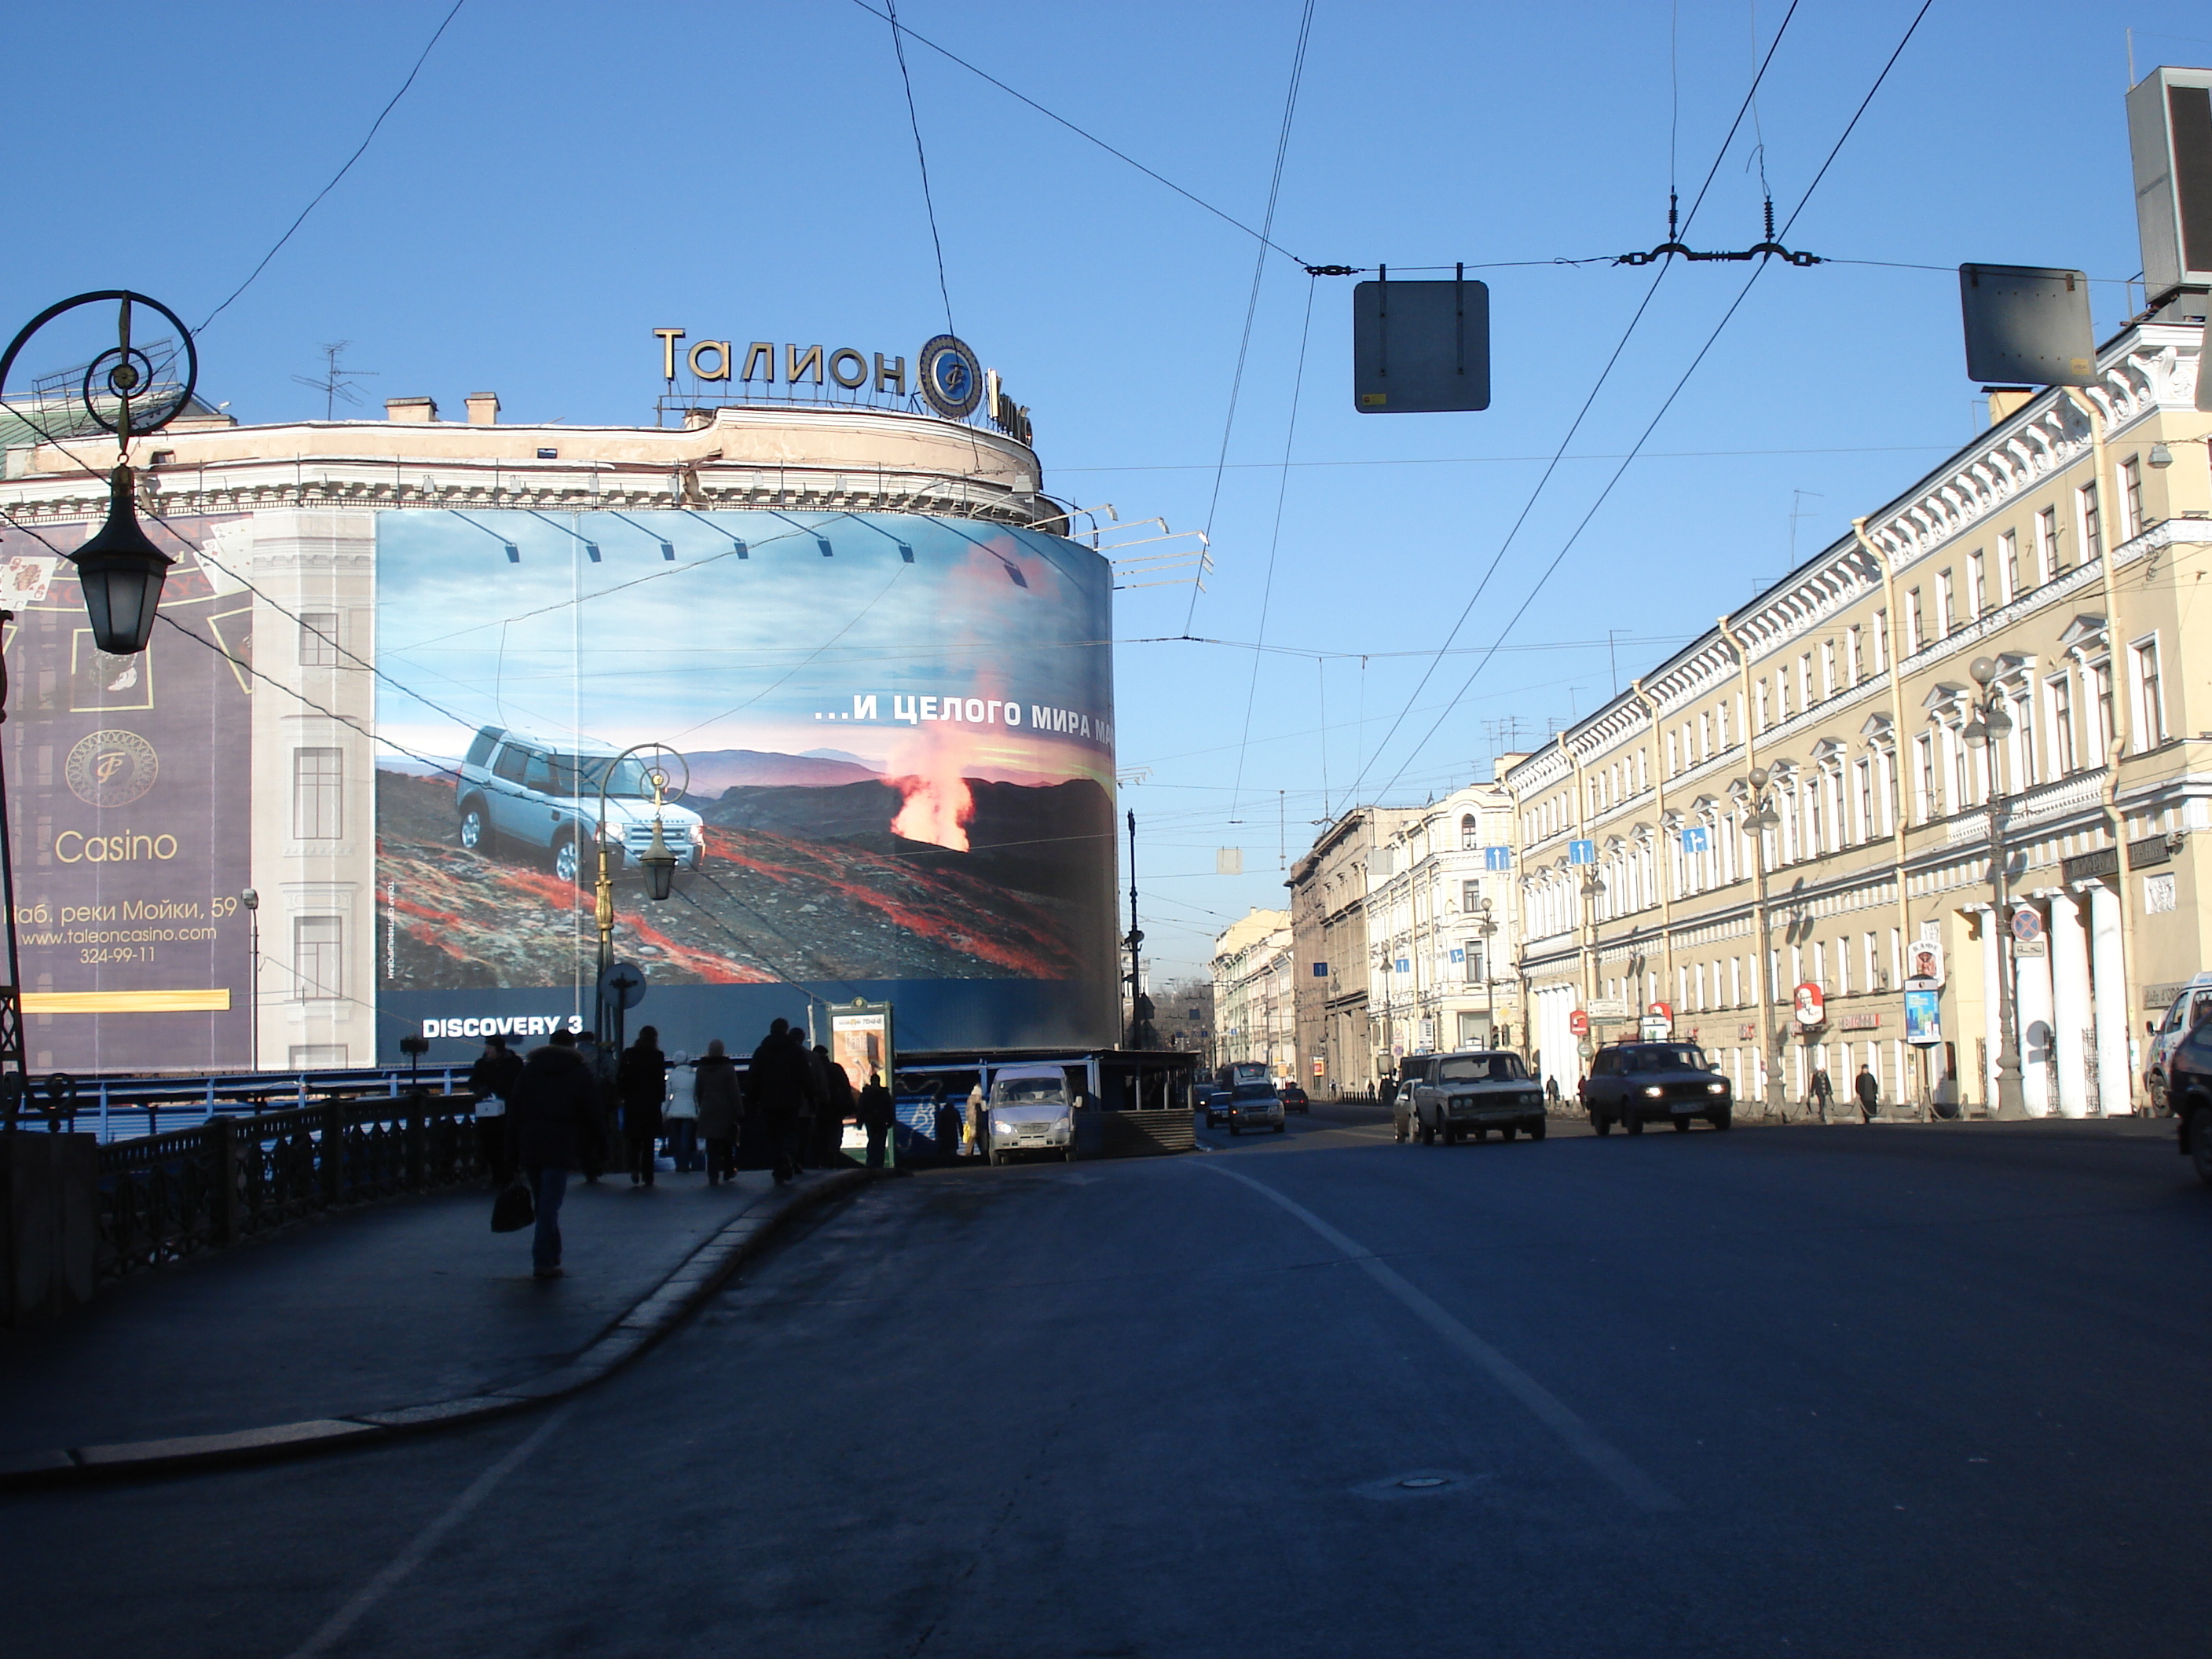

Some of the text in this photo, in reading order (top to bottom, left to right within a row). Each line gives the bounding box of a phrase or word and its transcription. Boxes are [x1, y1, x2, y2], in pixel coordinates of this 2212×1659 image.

[652, 328, 905, 397] Талион
[893, 694, 1021, 726] ЦЕЛОГО
[1032, 705, 1091, 738] МИРА
[1095, 718, 1114, 747] МА
[55, 829, 178, 864] Casino
[60, 904, 116, 927] реки
[123, 899, 205, 921] Мойки,
[211, 896, 237, 918] 59
[21, 926, 217, 945] www.taleoncasino.com
[80, 947, 156, 964] 324-99-11
[422, 1015, 583, 1038] DISCOVERY 3
